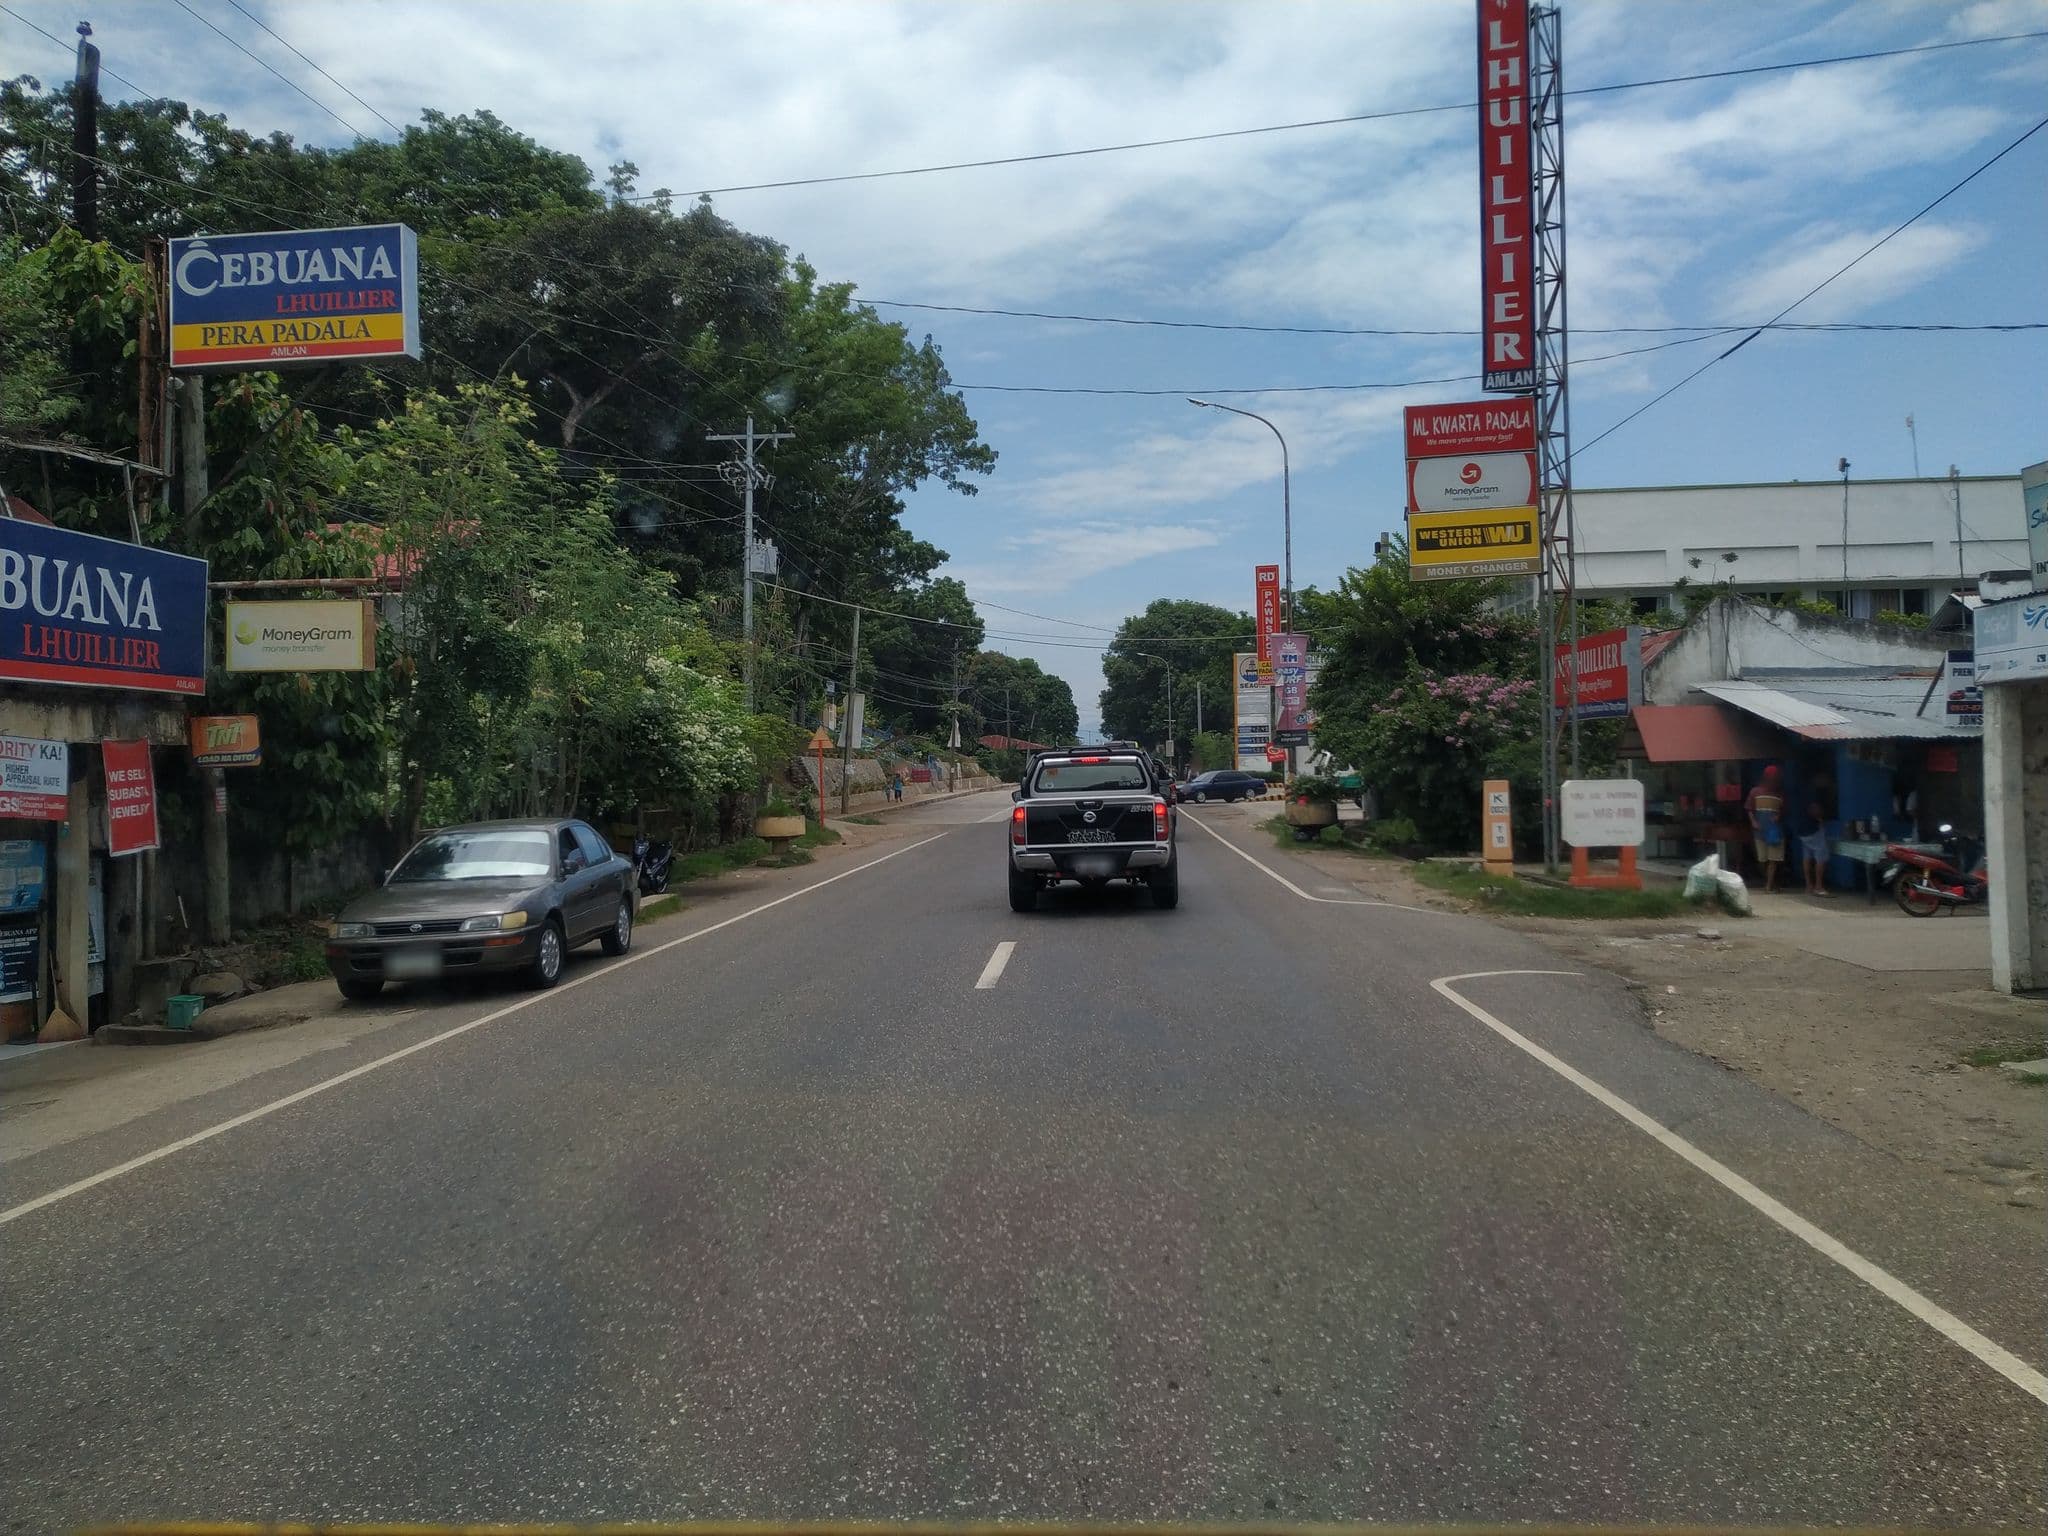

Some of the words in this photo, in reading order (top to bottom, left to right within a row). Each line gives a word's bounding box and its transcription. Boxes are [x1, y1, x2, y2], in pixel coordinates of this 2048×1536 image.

[1488, 20, 1524, 363] LHUILLIER
[176, 240, 397, 296] CEBUANA
[276, 289, 397, 313] LHUILLIER
[201, 324, 263, 346] PERA
[272, 318, 372, 344] PADALA
[270, 345, 307, 357] AMLAN
[1485, 367, 1533, 388] AMLAN
[1413, 419, 1429, 437] ML
[1433, 414, 1481, 435] KWARTA
[1486, 410, 1530, 430] PADALA
[1444, 485, 1499, 496] MoneyGram
[1419, 528, 1482, 540] WESTERN
[1439, 537, 1482, 547] UNION
[1259, 572, 1275, 582] RD
[1426, 564, 1468, 577] MONEY
[1472, 562, 1529, 573] CHANGER
[262, 627, 352, 644] MoneyGram
[23, 623, 161, 670] LHUILLIER
[262, 645, 291, 654] money
[1576, 643, 1619, 675] HUILLIER
[207, 721, 246, 747] TNT
[40, 744, 62, 760] KA!
[5, 774, 41, 786] APPRAISAL
[43, 775, 60, 787] RATE
[109, 769, 125, 783] WE
